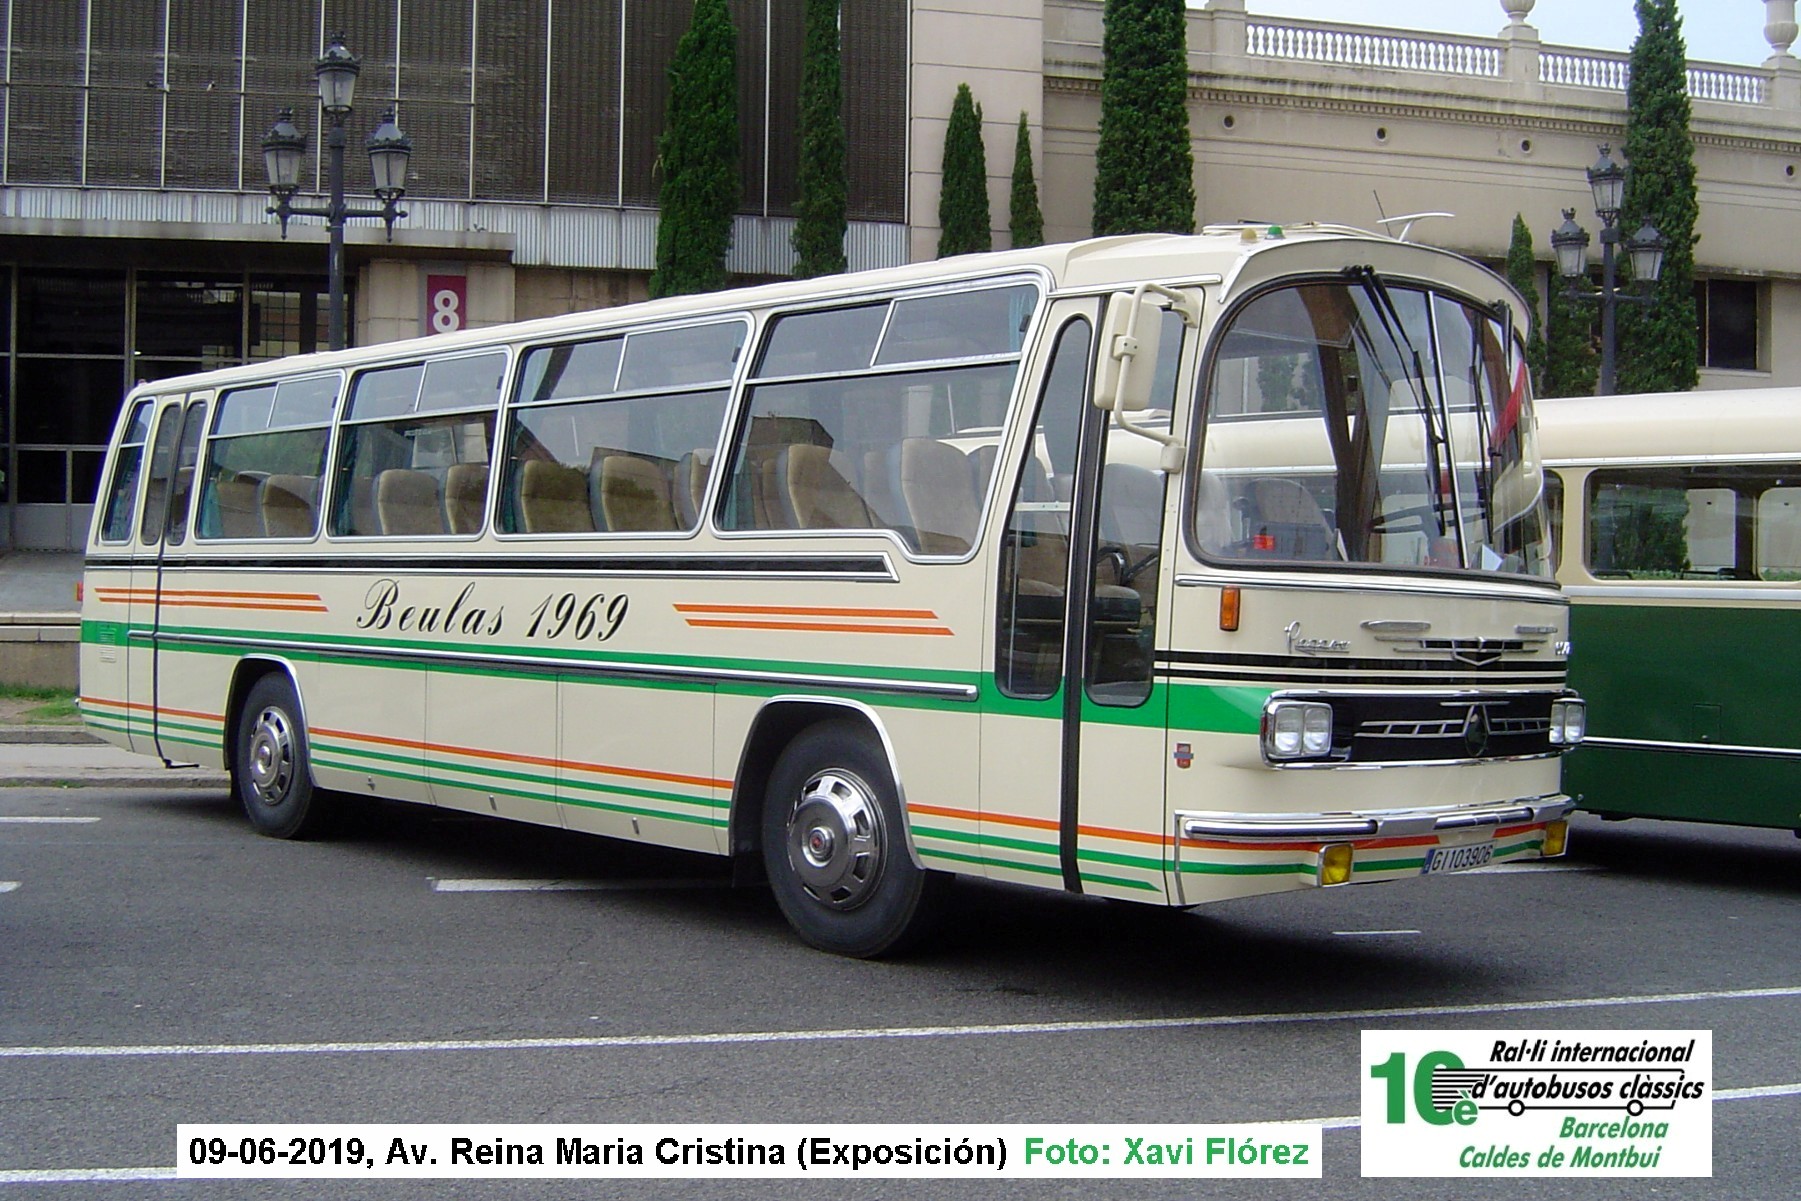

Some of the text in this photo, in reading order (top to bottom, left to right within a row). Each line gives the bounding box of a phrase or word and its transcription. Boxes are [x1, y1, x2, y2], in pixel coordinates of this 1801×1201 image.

[433, 289, 460, 334] 8
[356, 578, 629, 642] Beulas 1969
